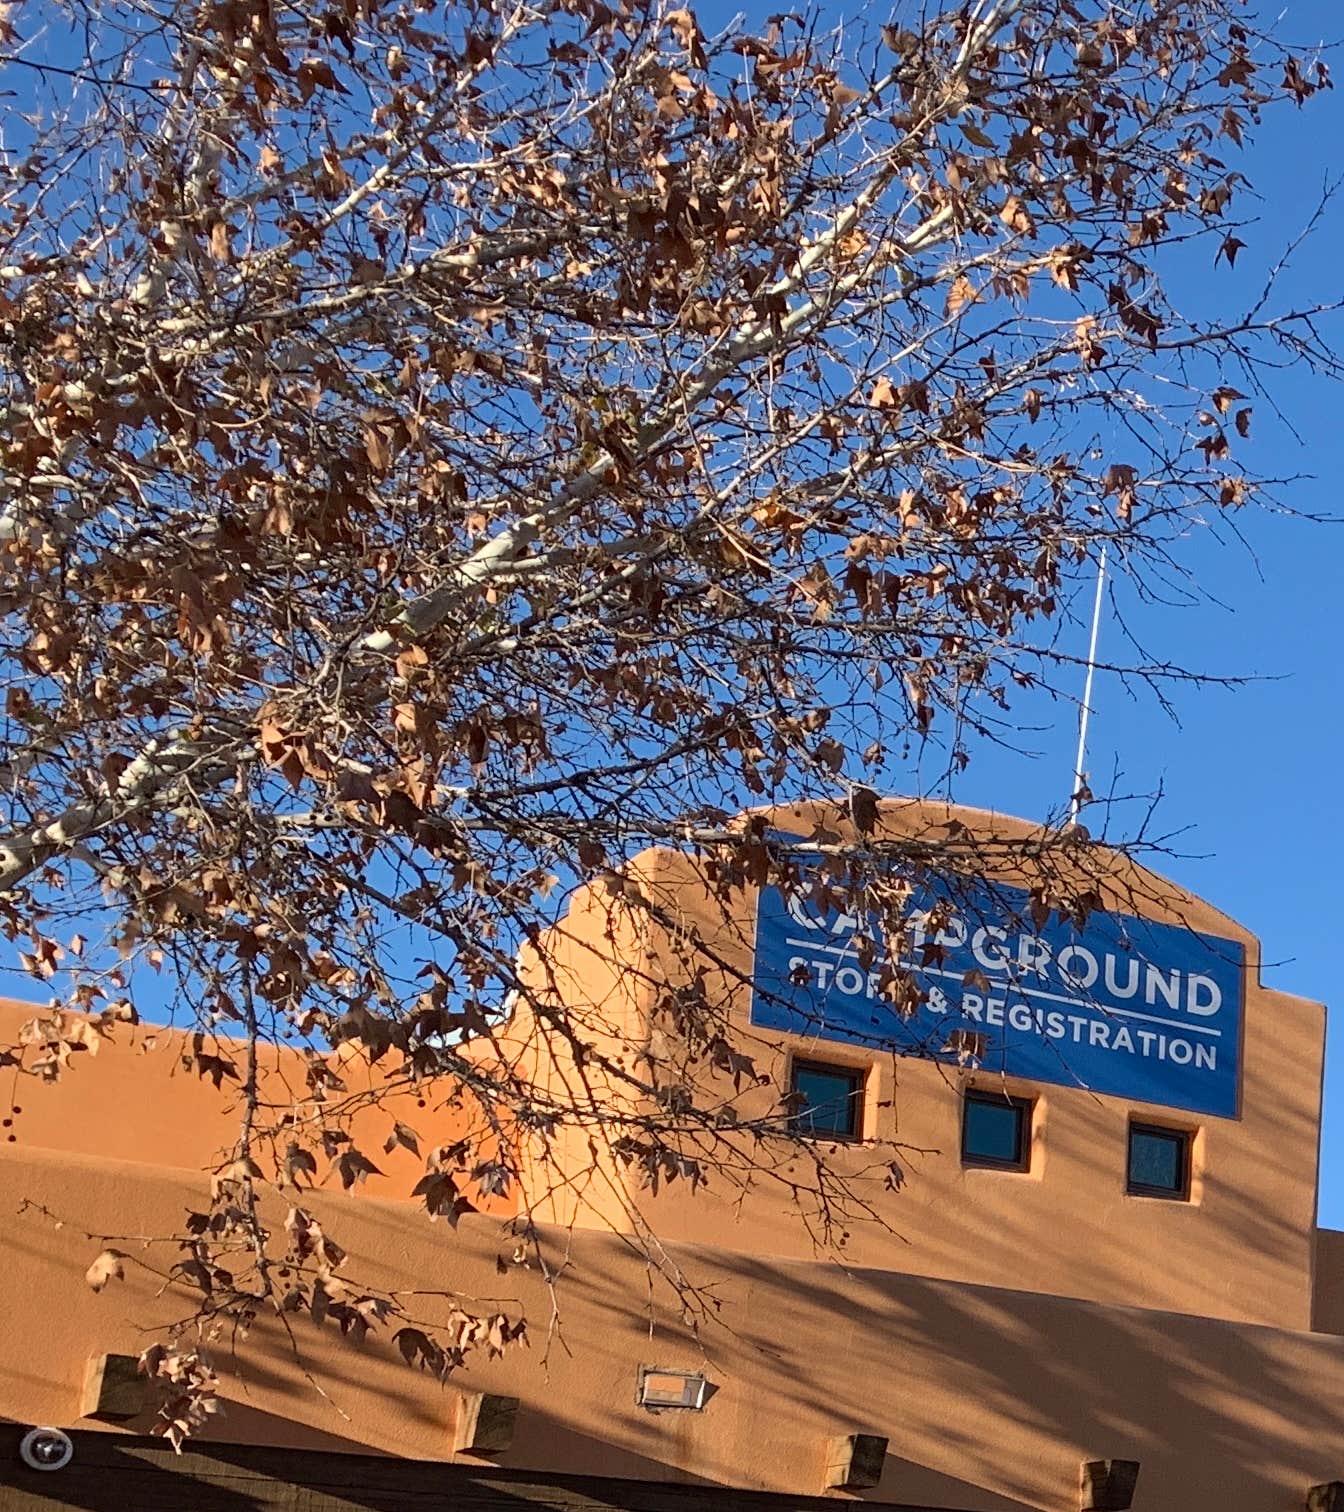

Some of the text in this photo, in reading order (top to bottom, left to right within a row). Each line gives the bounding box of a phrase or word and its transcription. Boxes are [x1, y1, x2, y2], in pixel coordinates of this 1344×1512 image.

[788, 956, 1218, 1072] STOR & REGISTRATION
